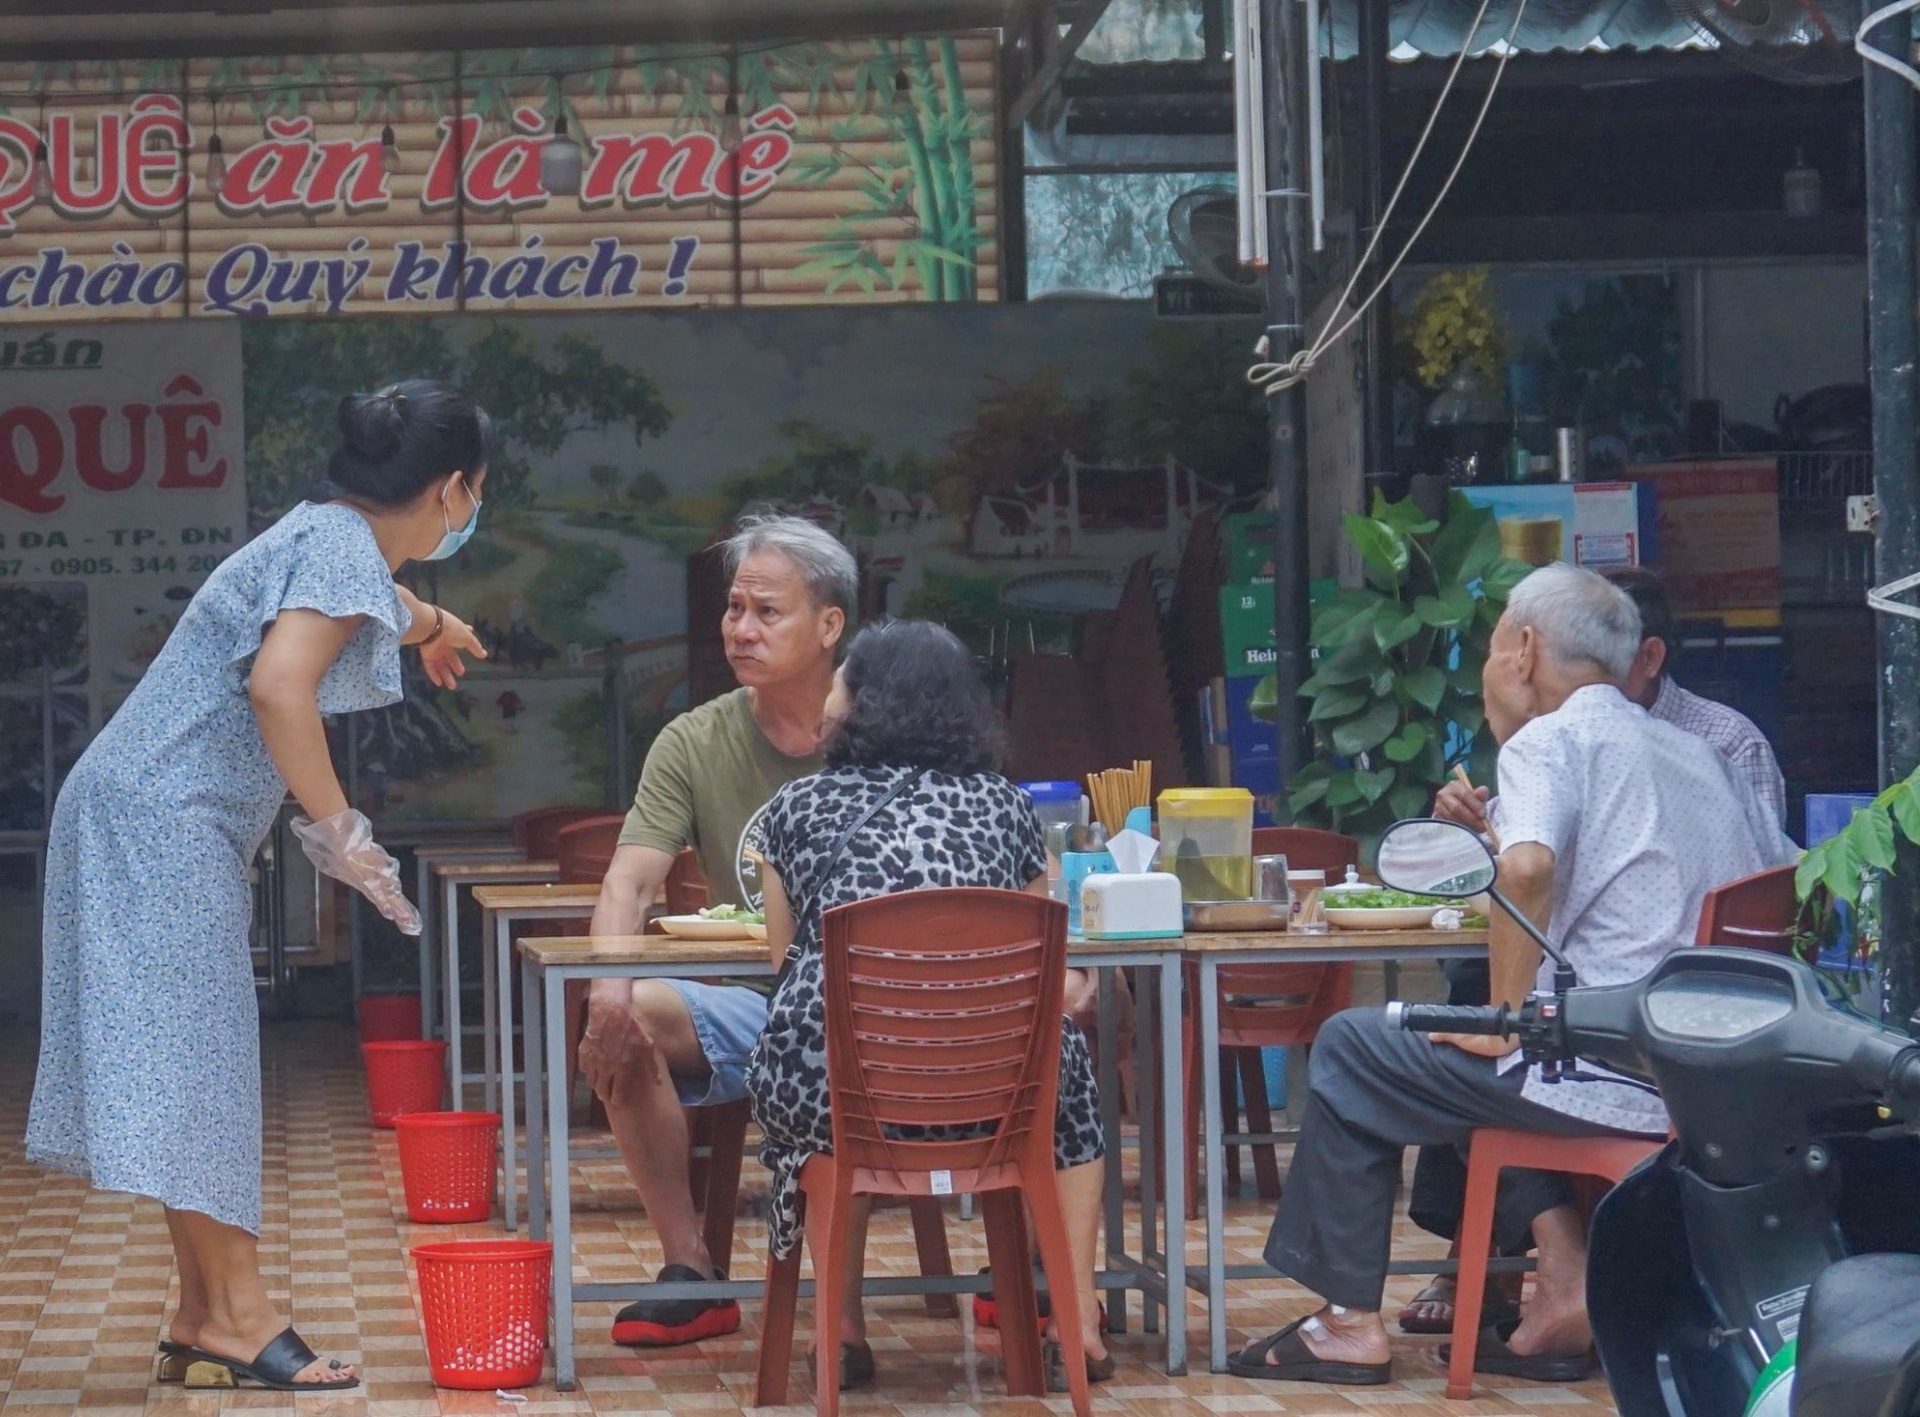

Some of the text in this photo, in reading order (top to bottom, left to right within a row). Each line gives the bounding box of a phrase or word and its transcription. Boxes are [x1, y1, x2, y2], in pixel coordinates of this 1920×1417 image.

[218, 116, 393, 208] ăn
[424, 107, 551, 204] là
[581, 103, 797, 203] mê
[0, 240, 185, 308] chào
[203, 237, 370, 316] Quý
[386, 234, 641, 302] khách
[0, 374, 228, 514] QUÊ
[186, 554, 228, 573] 20
